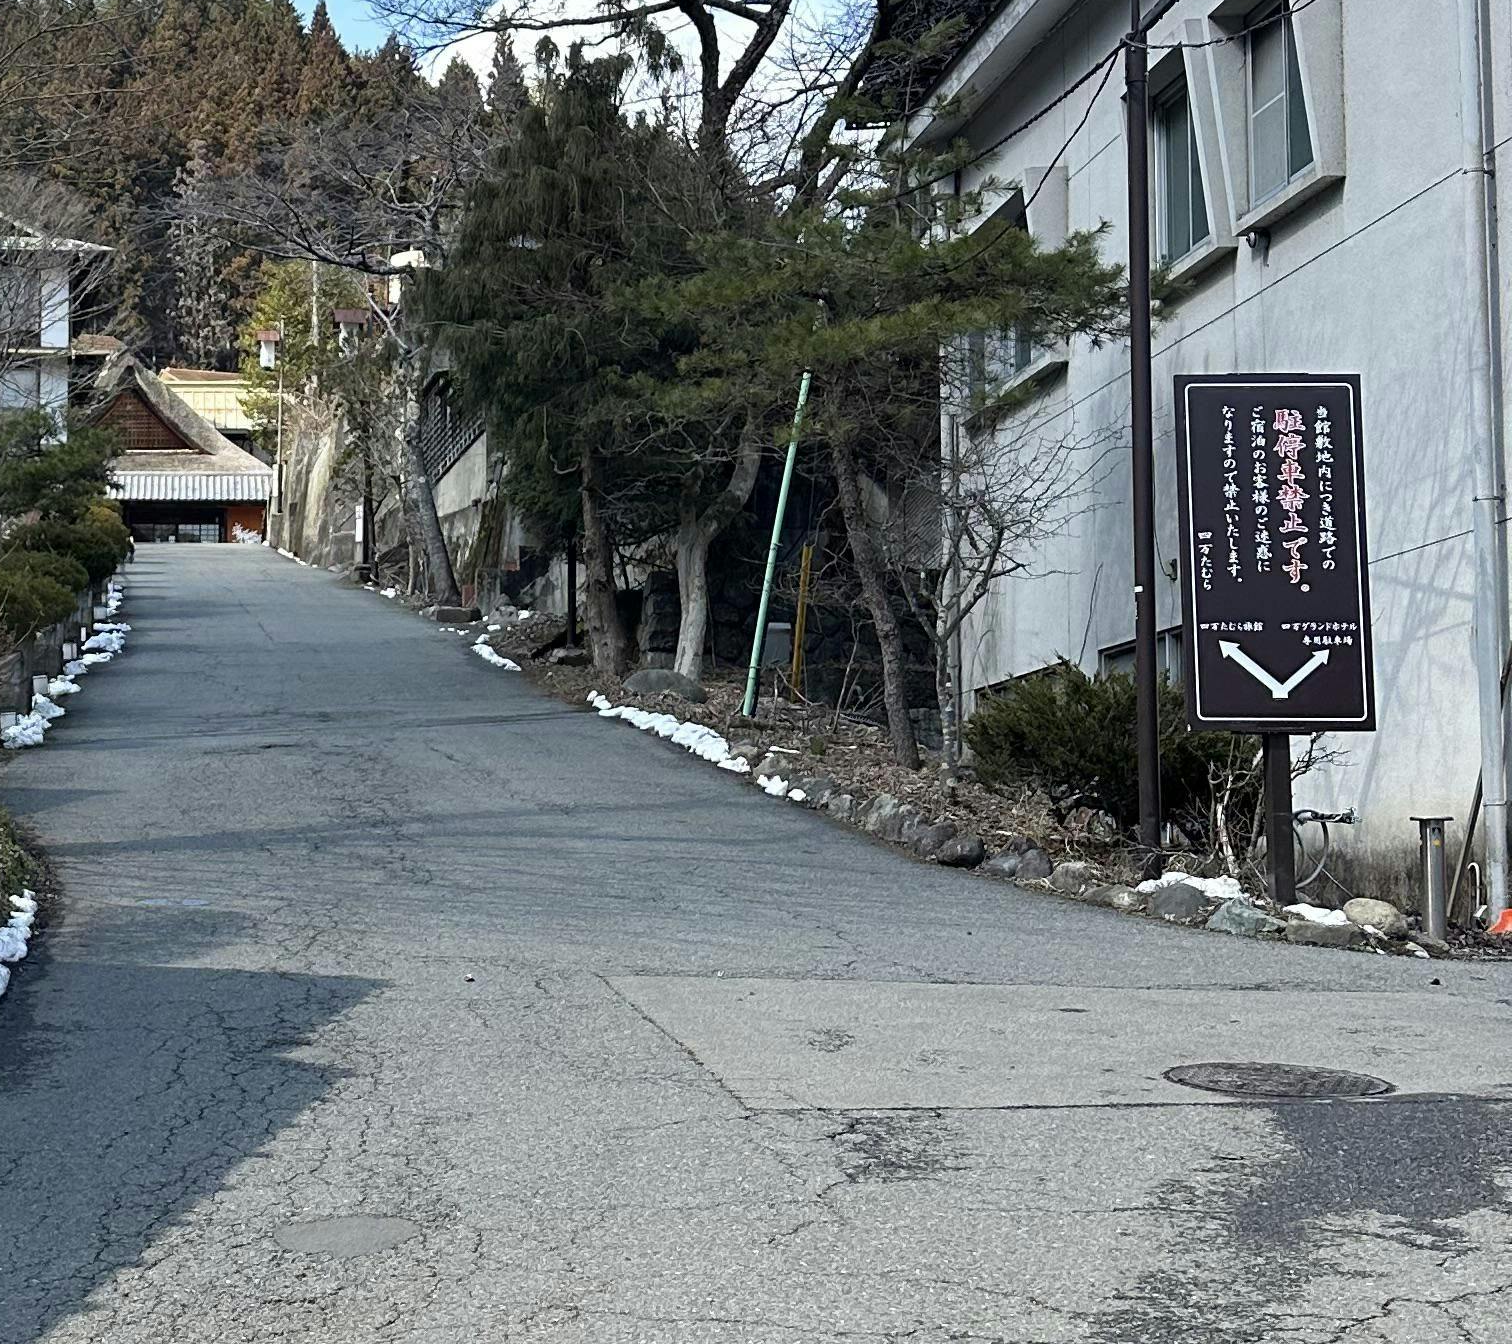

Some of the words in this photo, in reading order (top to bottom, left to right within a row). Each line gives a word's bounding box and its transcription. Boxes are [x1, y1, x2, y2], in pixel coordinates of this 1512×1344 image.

[1197, 531, 1213, 591] 四万たむら
